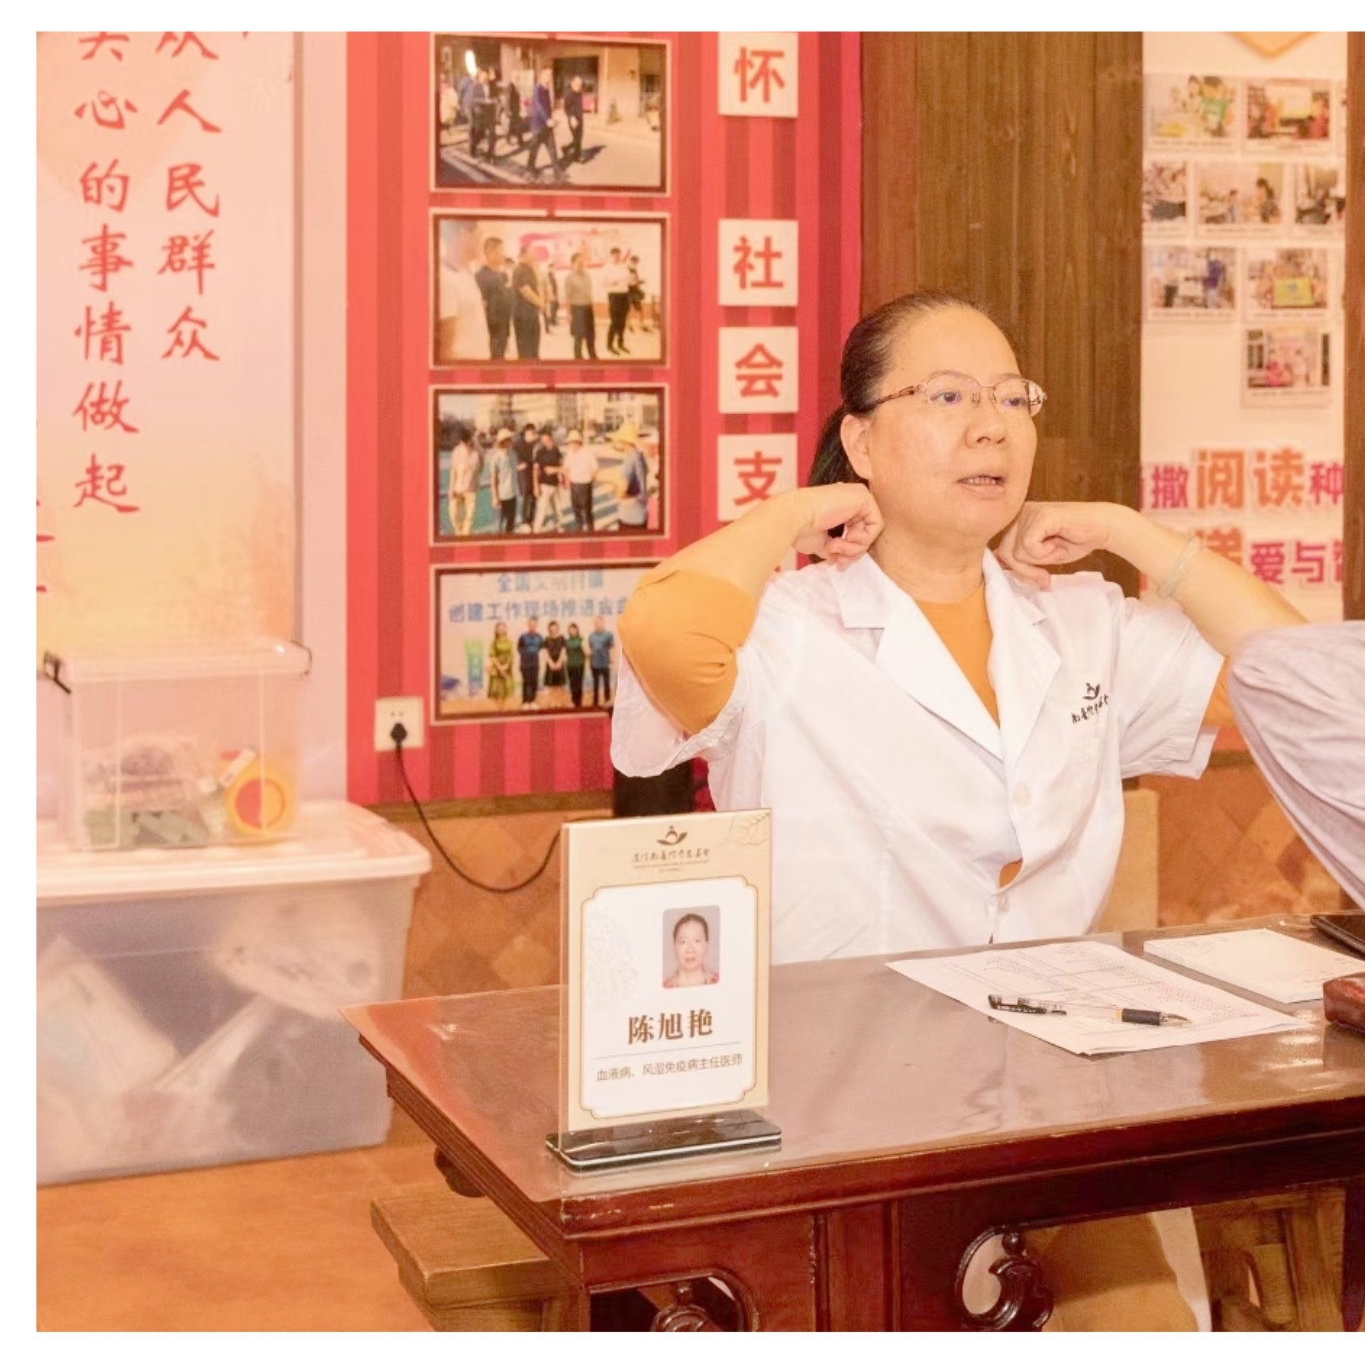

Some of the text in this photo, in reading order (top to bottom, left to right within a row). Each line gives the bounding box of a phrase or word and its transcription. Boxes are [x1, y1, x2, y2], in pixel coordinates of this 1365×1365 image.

[735, 47, 786, 104] 怀
[1140, 448, 1343, 509] 撒阅读种
[628, 1008, 714, 1044] 陈旭艳
[596, 1053, 743, 1082] 血液病、风湿免疫病主任医师
